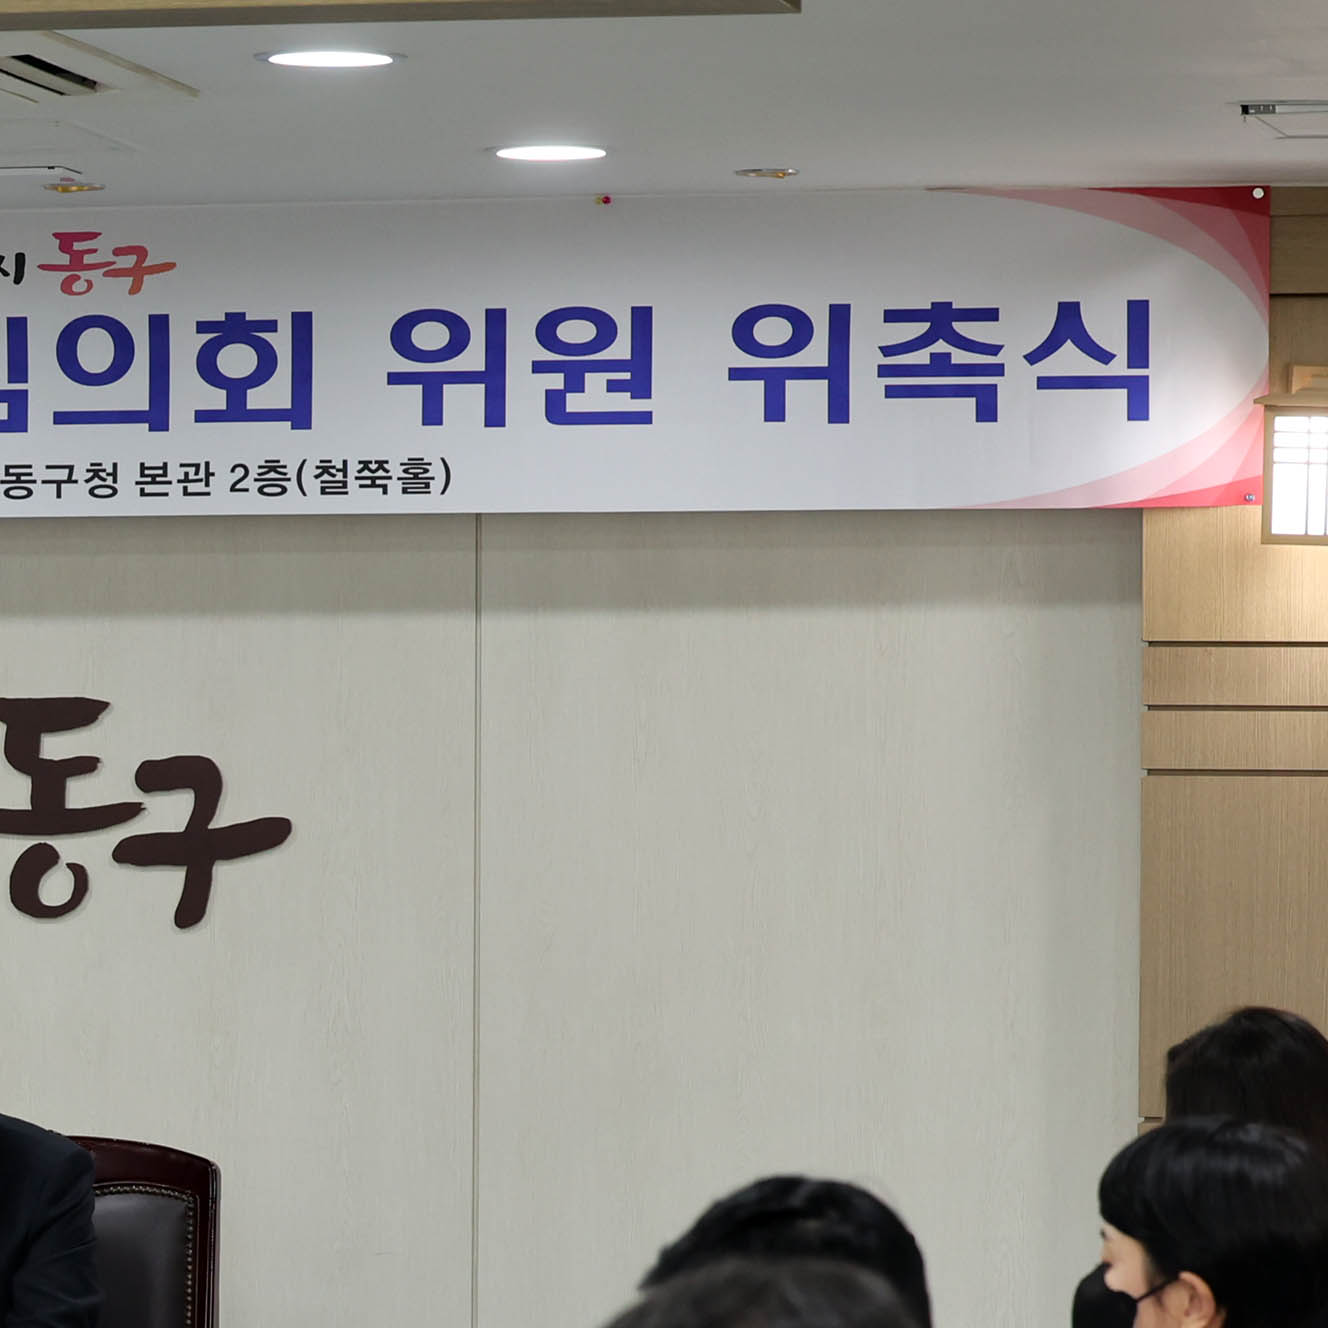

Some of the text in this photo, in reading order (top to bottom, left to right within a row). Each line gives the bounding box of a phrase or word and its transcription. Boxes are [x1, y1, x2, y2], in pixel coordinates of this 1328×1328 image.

[36, 231, 177, 296] 동구
[386, 305, 654, 429] 위원
[727, 298, 1151, 425] 위촉식
[134, 460, 216, 498] 본관
[229, 456, 452, 498] 2층(철쭉홀)
